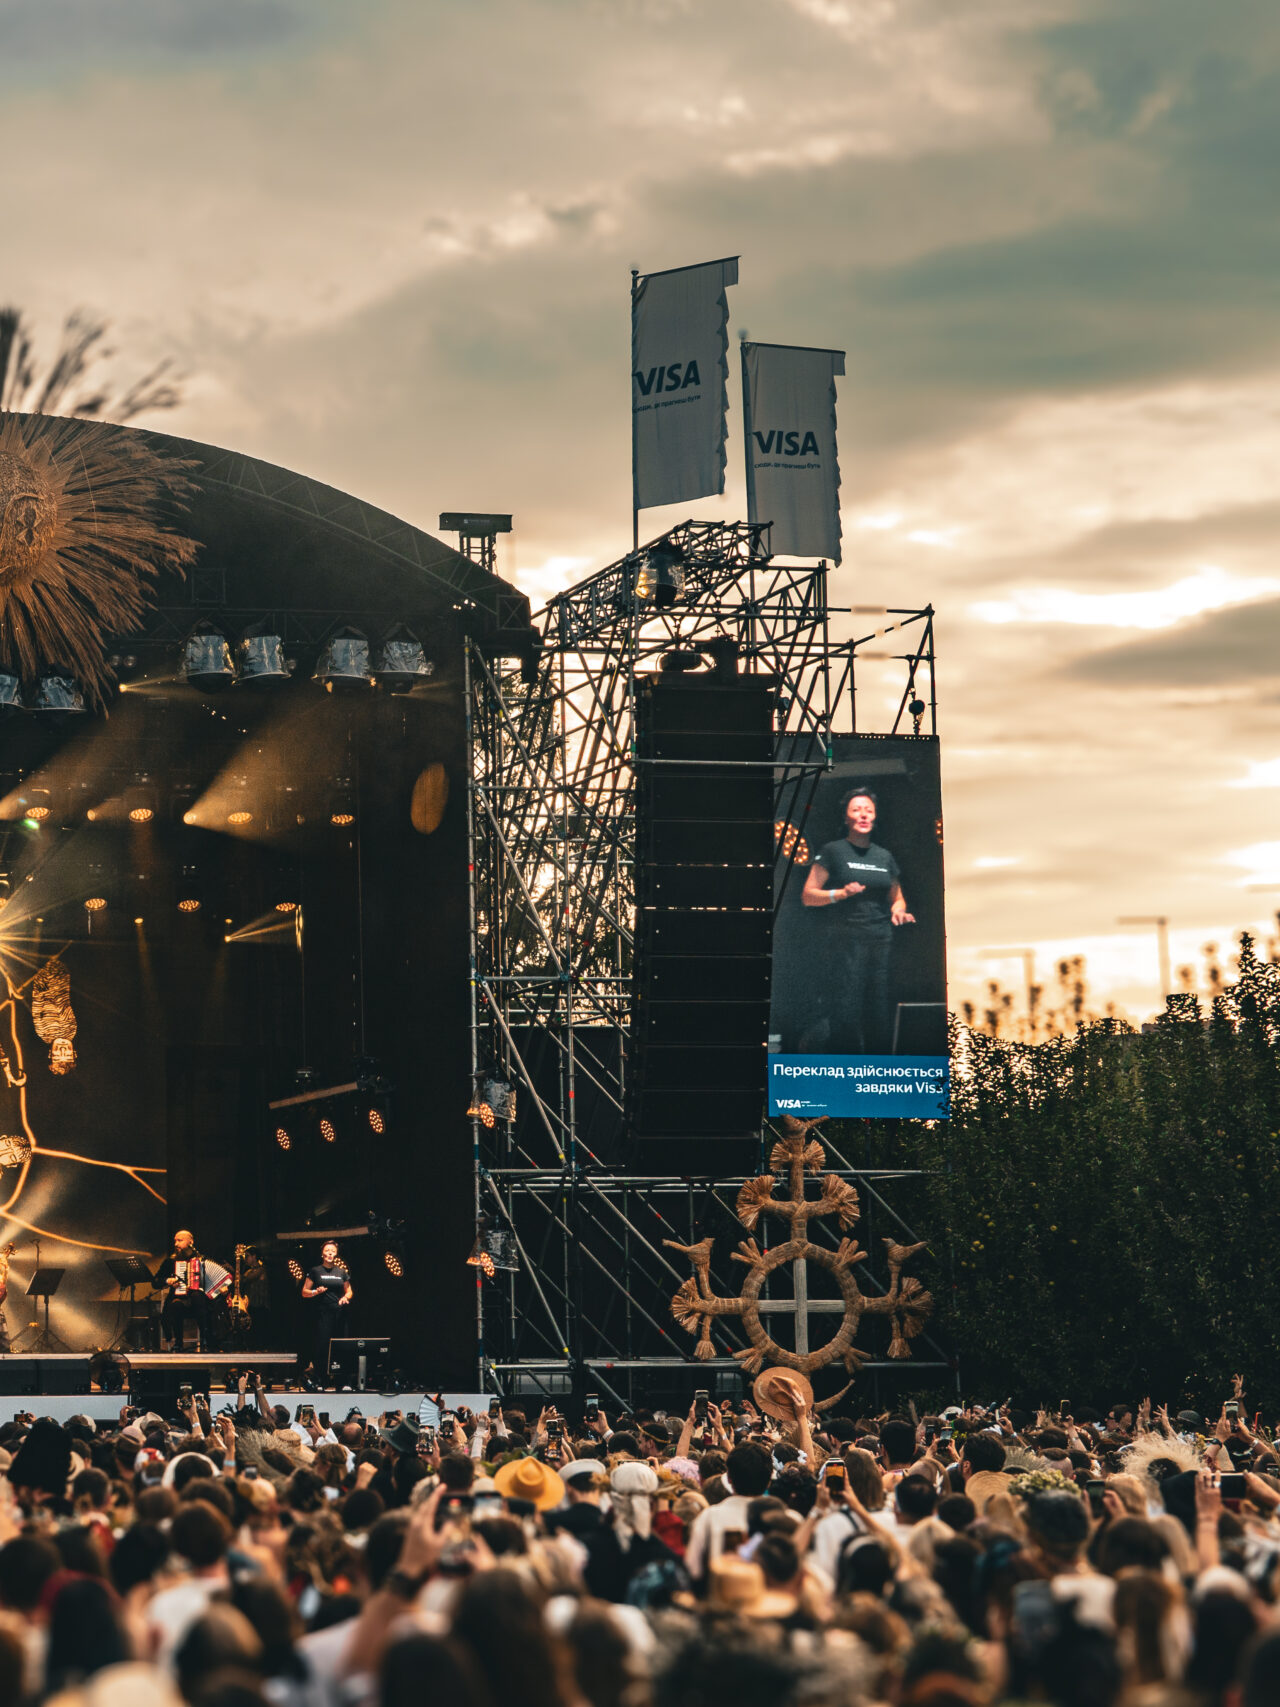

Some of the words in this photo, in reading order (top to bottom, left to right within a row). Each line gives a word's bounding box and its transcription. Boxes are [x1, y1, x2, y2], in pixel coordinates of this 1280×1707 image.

[632, 360, 701, 396] VISA
[752, 430, 820, 456] VISA
[773, 1063, 845, 1079] Переклад
[847, 1065, 943, 1079] здійснюється
[855, 1083, 913, 1095] завдяки
[775, 1099, 801, 1108] VISA
